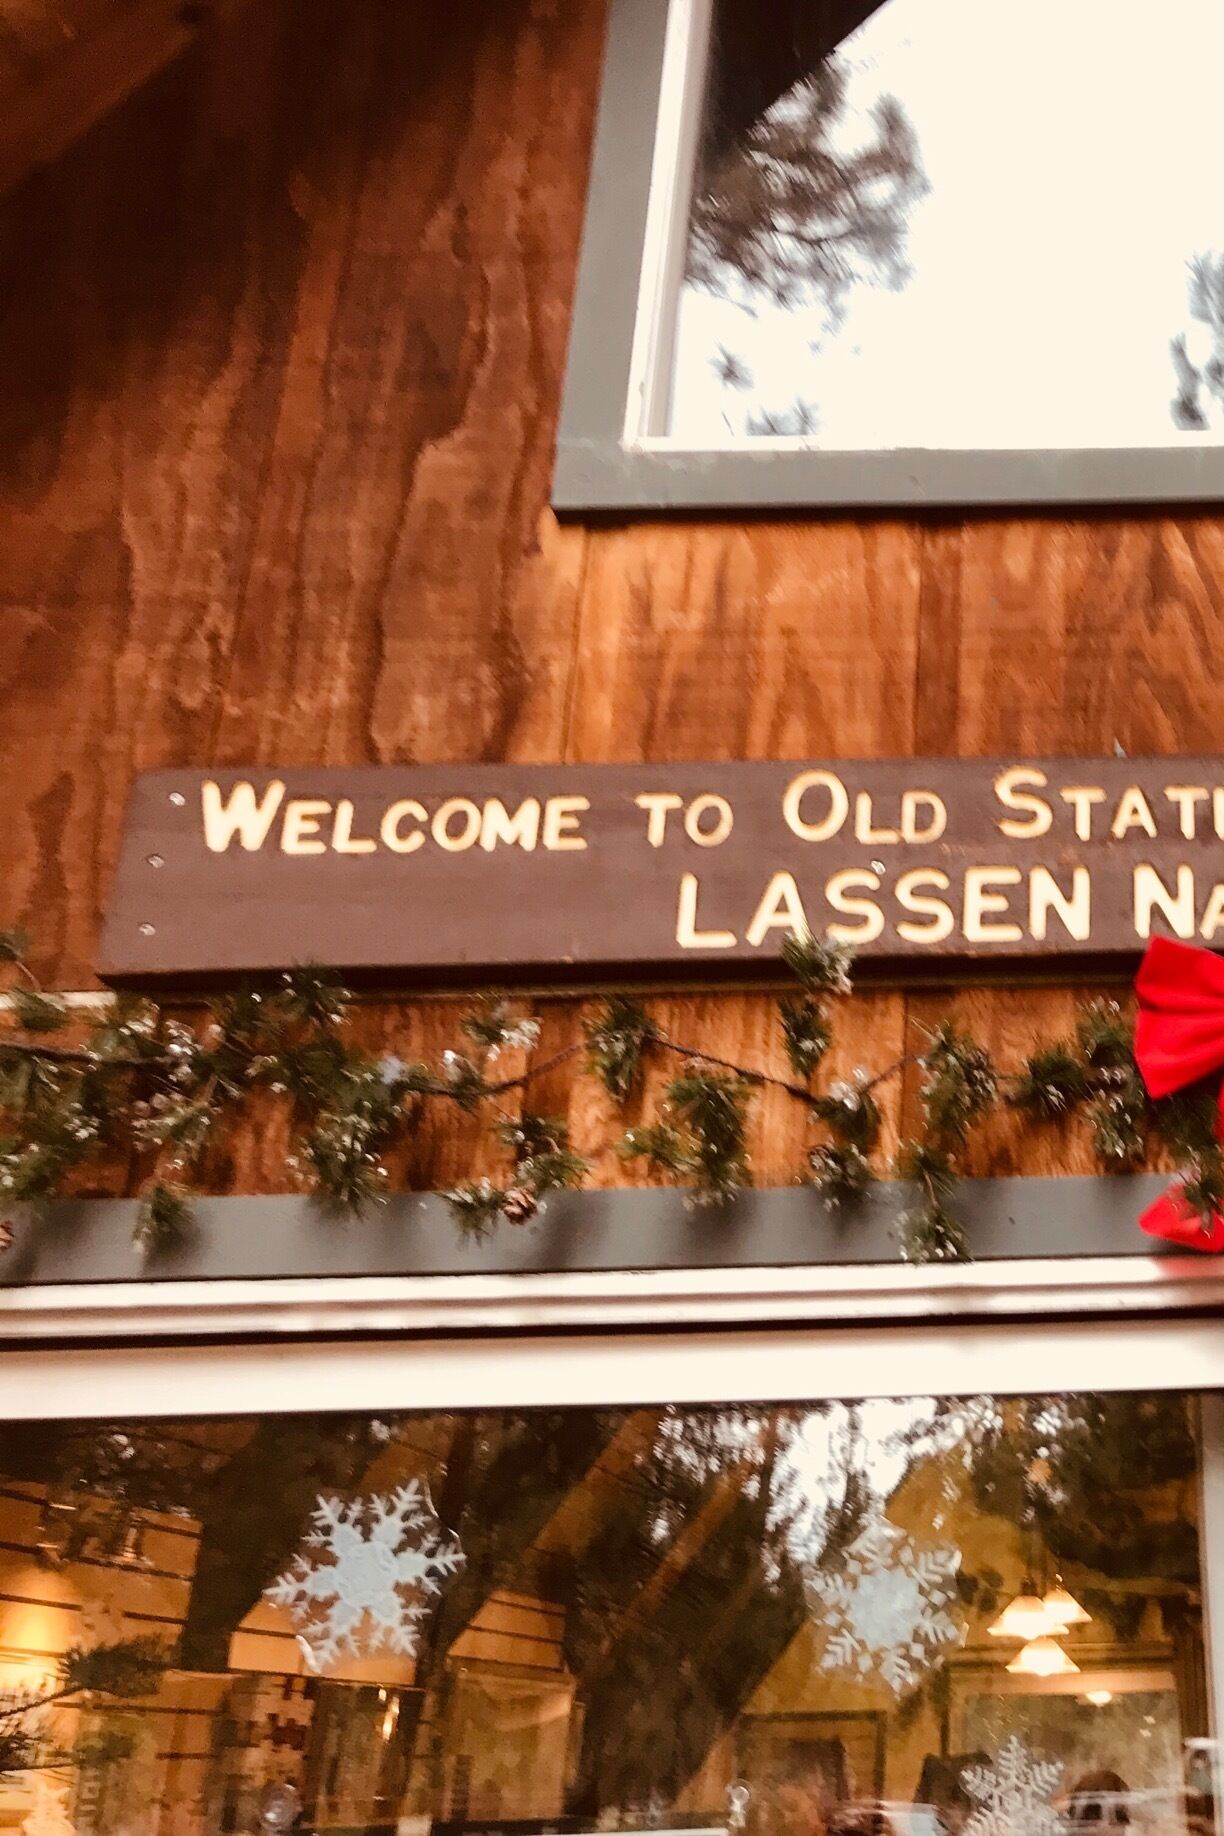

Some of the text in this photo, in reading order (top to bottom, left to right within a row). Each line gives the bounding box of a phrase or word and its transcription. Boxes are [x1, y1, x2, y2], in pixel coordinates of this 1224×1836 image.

[201, 780, 590, 854] WELCOME
[634, 792, 735, 849] TO
[782, 770, 949, 845] OLD
[675, 864, 1091, 950] LASSEN
